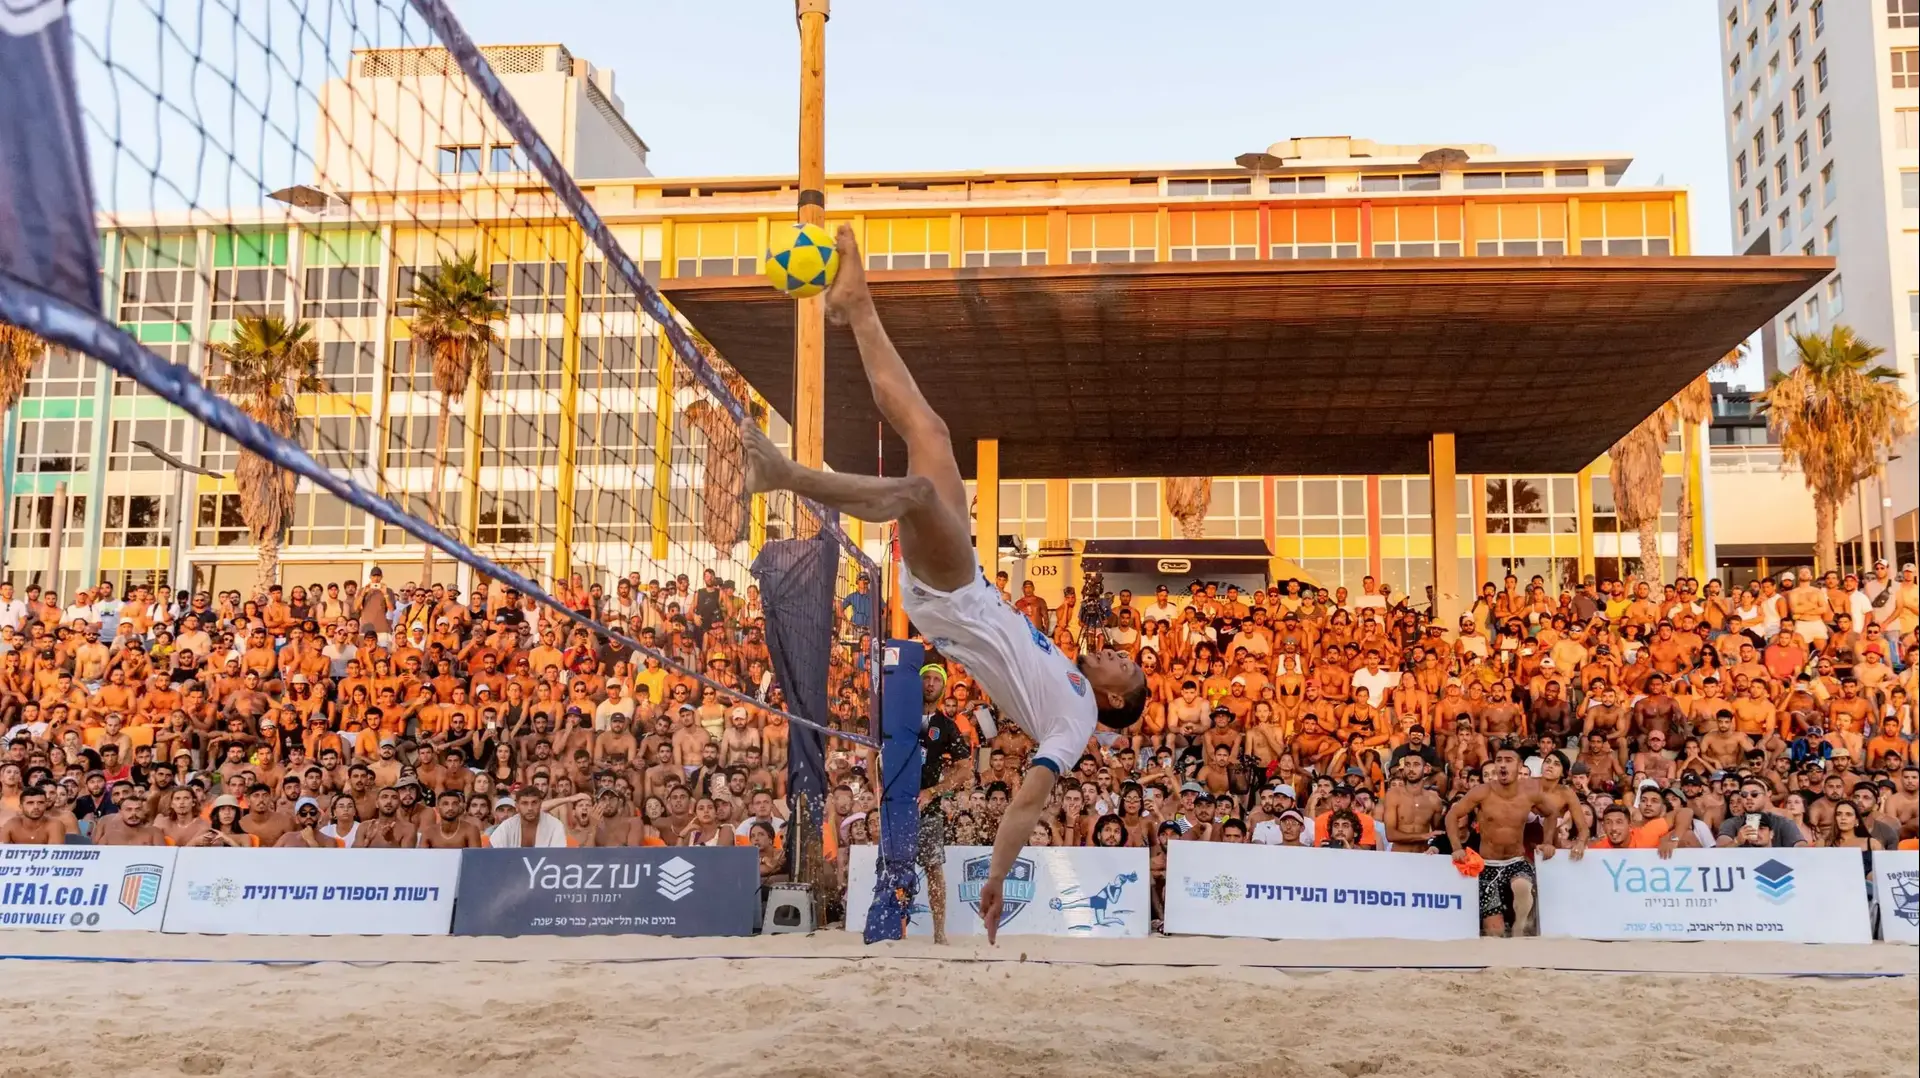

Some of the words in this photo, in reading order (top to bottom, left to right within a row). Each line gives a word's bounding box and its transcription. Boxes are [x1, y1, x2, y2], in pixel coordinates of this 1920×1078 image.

[1031, 565, 1057, 576] OB3
[5, 848, 49, 861] לקידום
[50, 850, 101, 860] העמותה
[522, 856, 604, 889] Yaaz
[609, 863, 651, 889] יעז
[1602, 859, 1694, 893] Yaaz
[1697, 866, 1746, 893] יעז
[2, 882, 108, 906] IFA1.co.il
[242, 885, 318, 900] העירונית
[322, 886, 389, 901] הספורט
[393, 886, 439, 901] רשות
[1245, 883, 1327, 903] העירונית
[1333, 888, 1406, 907] הספורט
[555, 893, 587, 903] ובנייה
[591, 893, 622, 903] יזמות
[1411, 892, 1462, 909] רשות
[1645, 898, 1680, 907] ובנייה
[1685, 898, 1718, 907] יזמות
[554, 917, 567, 926] 50
[569, 917, 587, 926] כבר
[634, 916, 649, 926] את
[651, 916, 676, 926] בונים
[1649, 922, 1662, 932] 50
[1665, 922, 1684, 932] כבר
[1737, 922, 1753, 932] את
[1756, 922, 1784, 932] בונים
